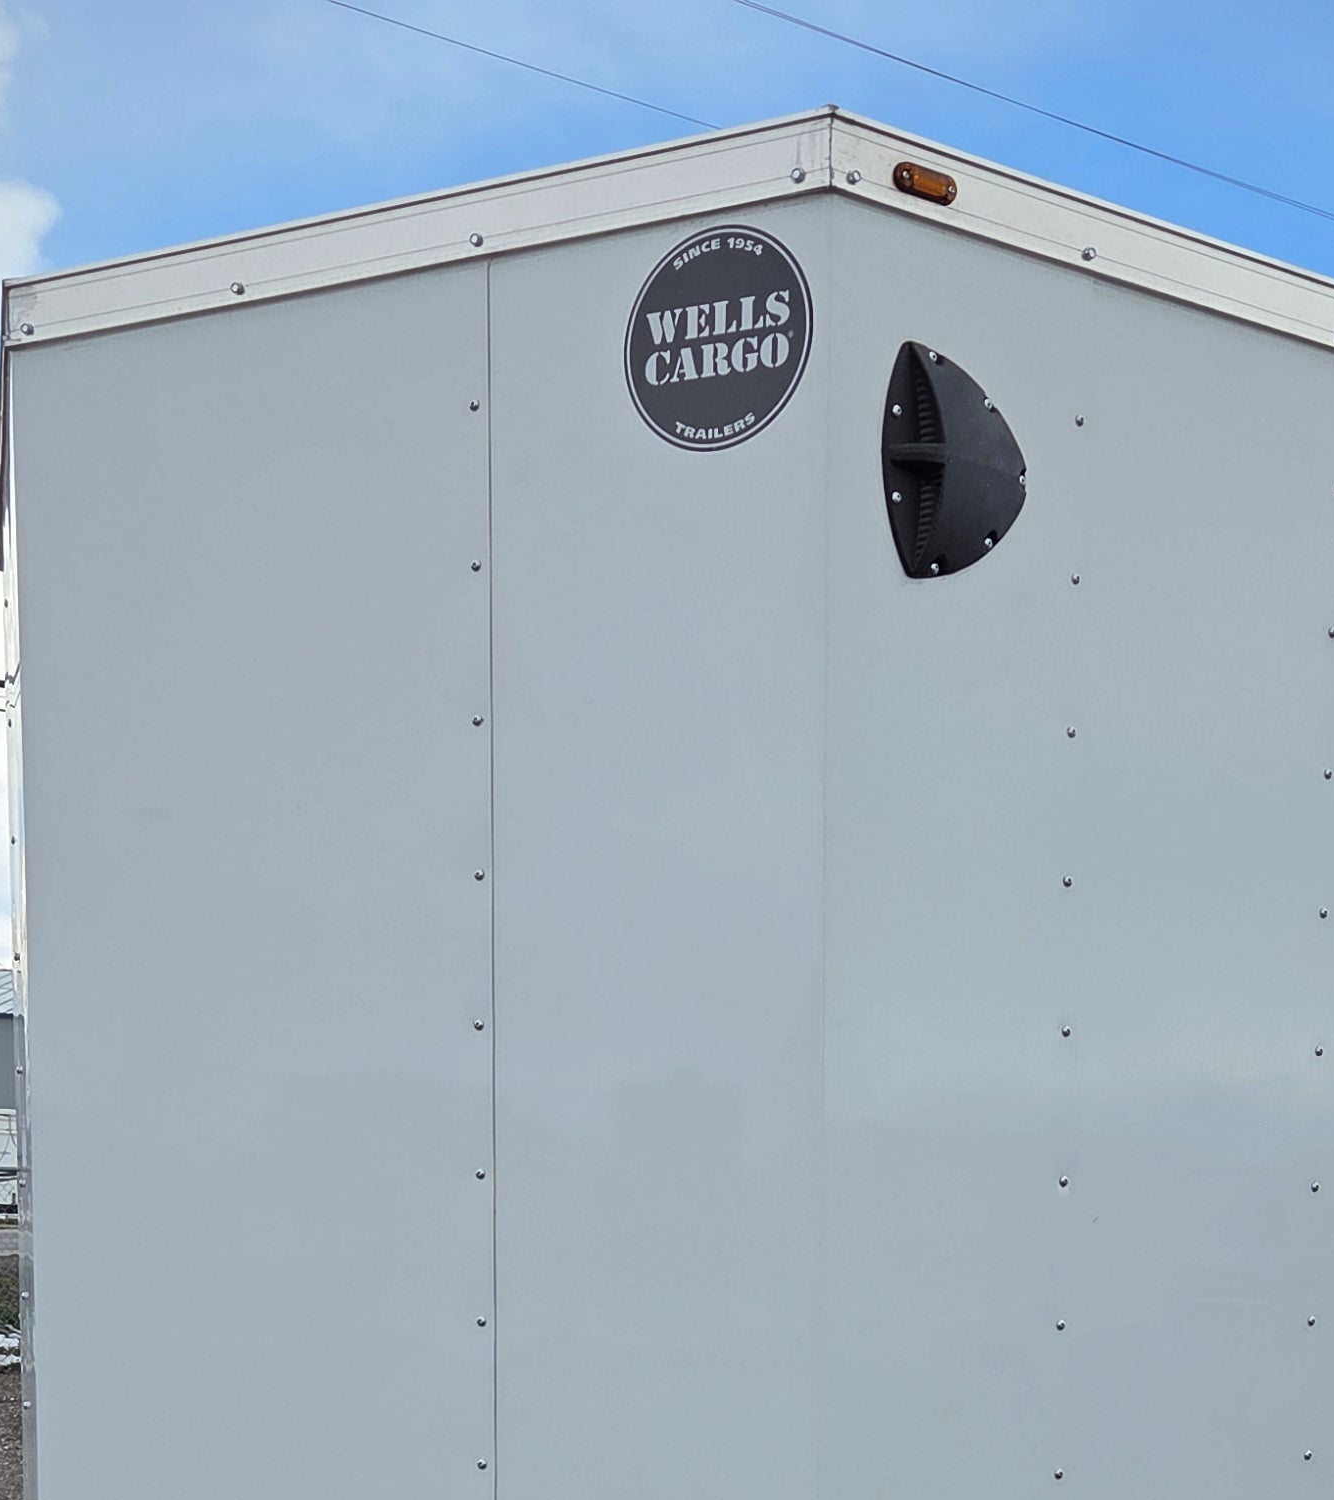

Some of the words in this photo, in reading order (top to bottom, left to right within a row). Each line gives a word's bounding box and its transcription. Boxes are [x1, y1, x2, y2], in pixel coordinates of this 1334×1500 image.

[673, 238, 721, 271] SINCE
[727, 237, 764, 256] 1954
[646, 290, 791, 345] WELLS
[645, 332, 790, 386] CARGO
[675, 412, 756, 440] TRAILERS
